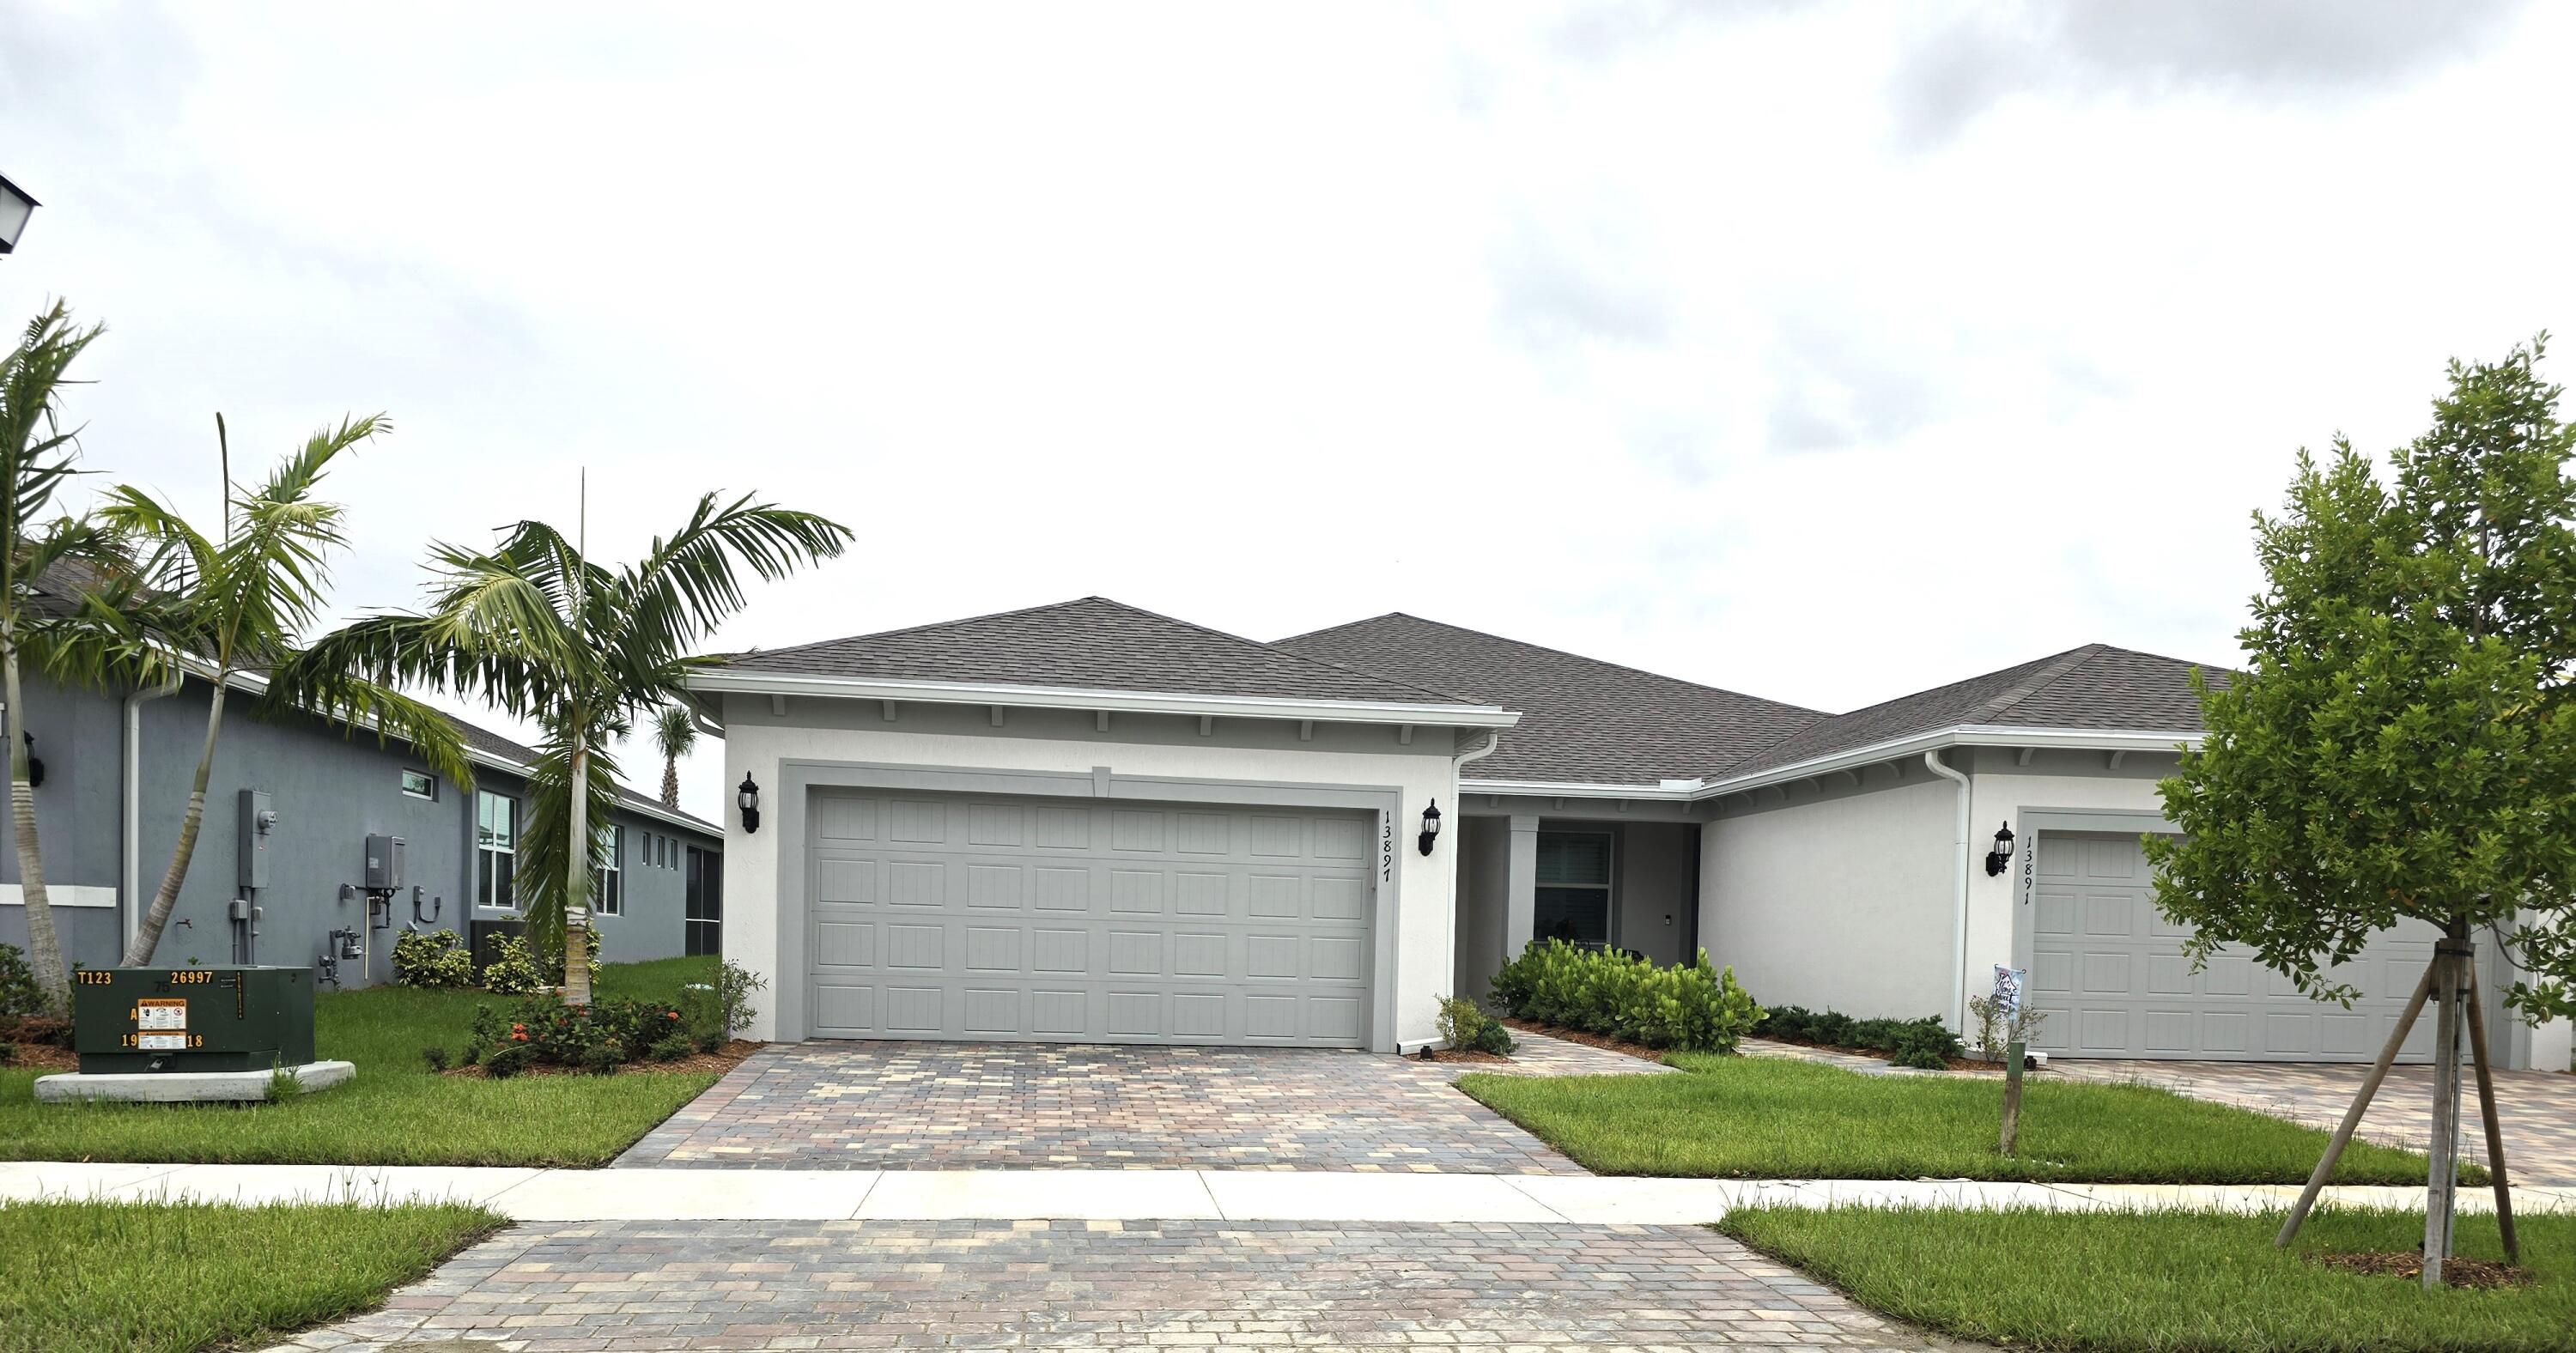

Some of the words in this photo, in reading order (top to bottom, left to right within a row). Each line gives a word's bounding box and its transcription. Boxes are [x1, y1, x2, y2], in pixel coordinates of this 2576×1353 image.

[1382, 810, 1392, 883] 13897
[2024, 835, 2033, 906] 13891
[77, 971, 112, 985] T123
[171, 971, 213, 984] 26997
[154, 980, 171, 993] 75
[130, 1008, 137, 1021] A
[121, 1034, 137, 1047] 19
[187, 1034, 203, 1047] 18
